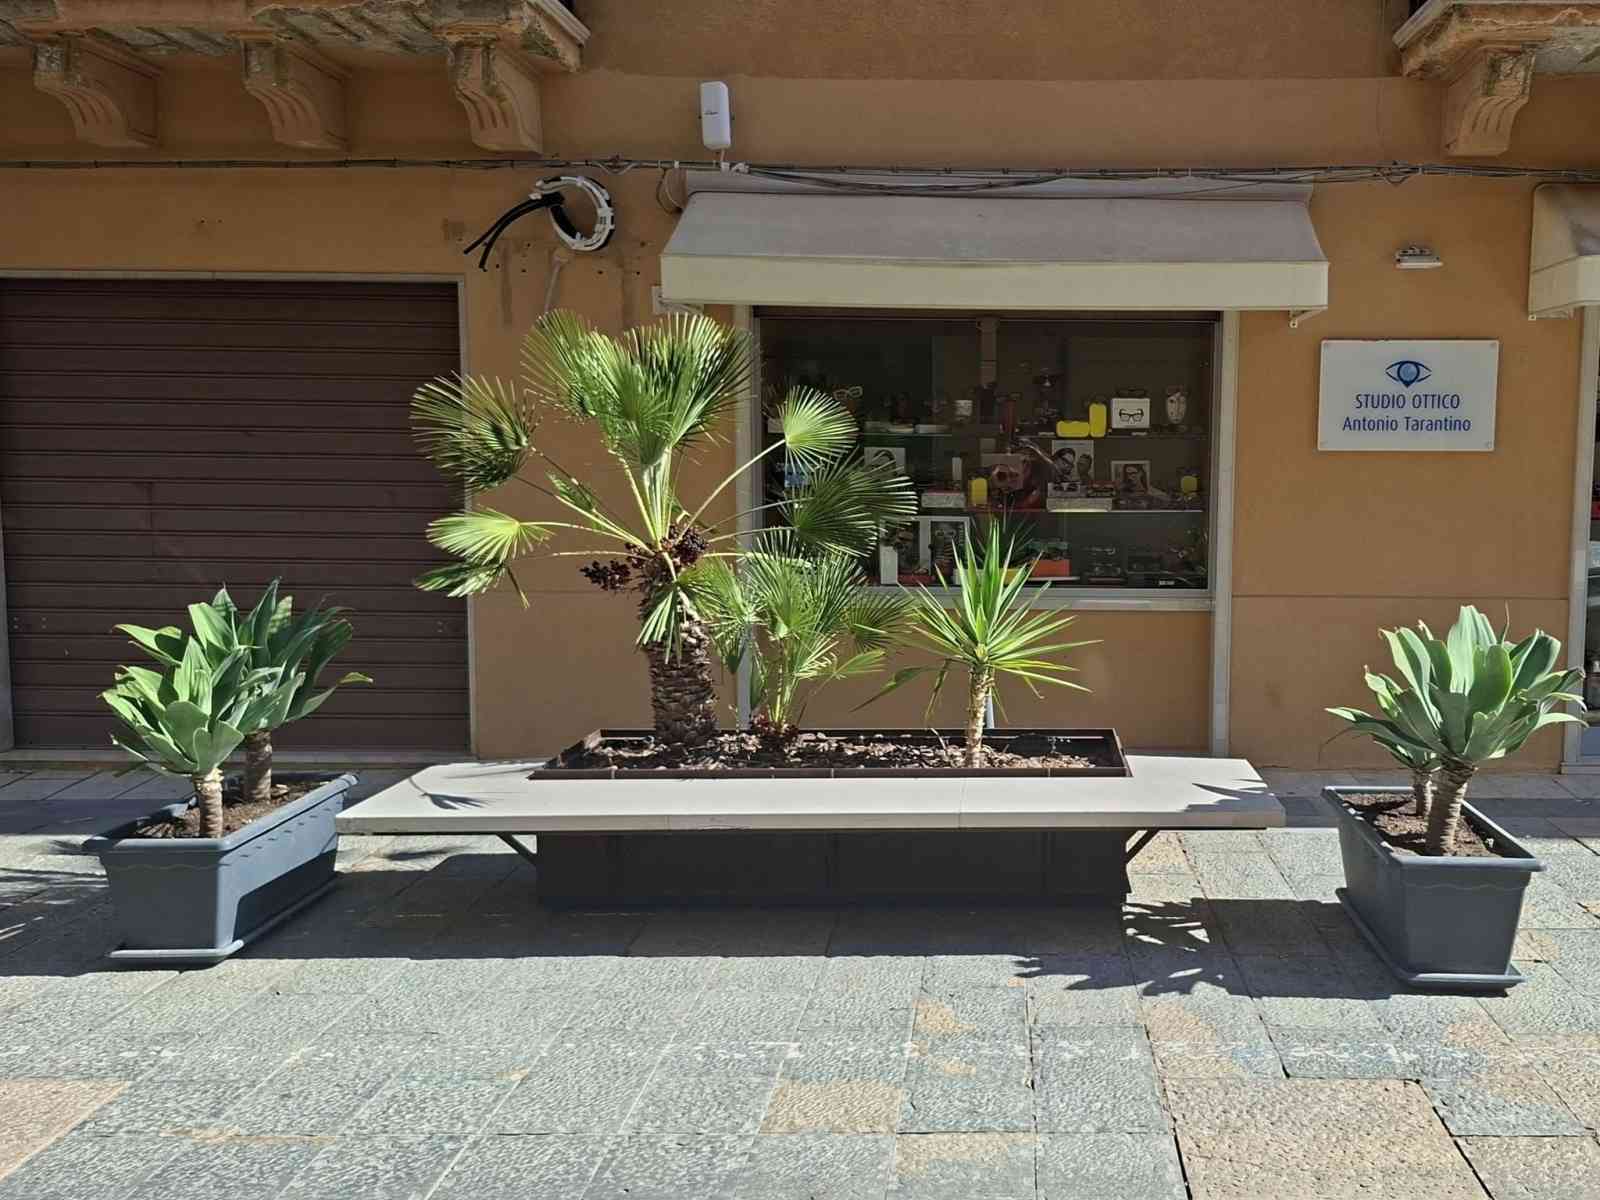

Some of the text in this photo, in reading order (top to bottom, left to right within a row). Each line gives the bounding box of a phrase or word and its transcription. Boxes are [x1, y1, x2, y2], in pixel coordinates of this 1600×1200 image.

[1355, 393, 1460, 410] STUDIO OTTICO
[1342, 415, 1472, 432] Antonio Tarantino
